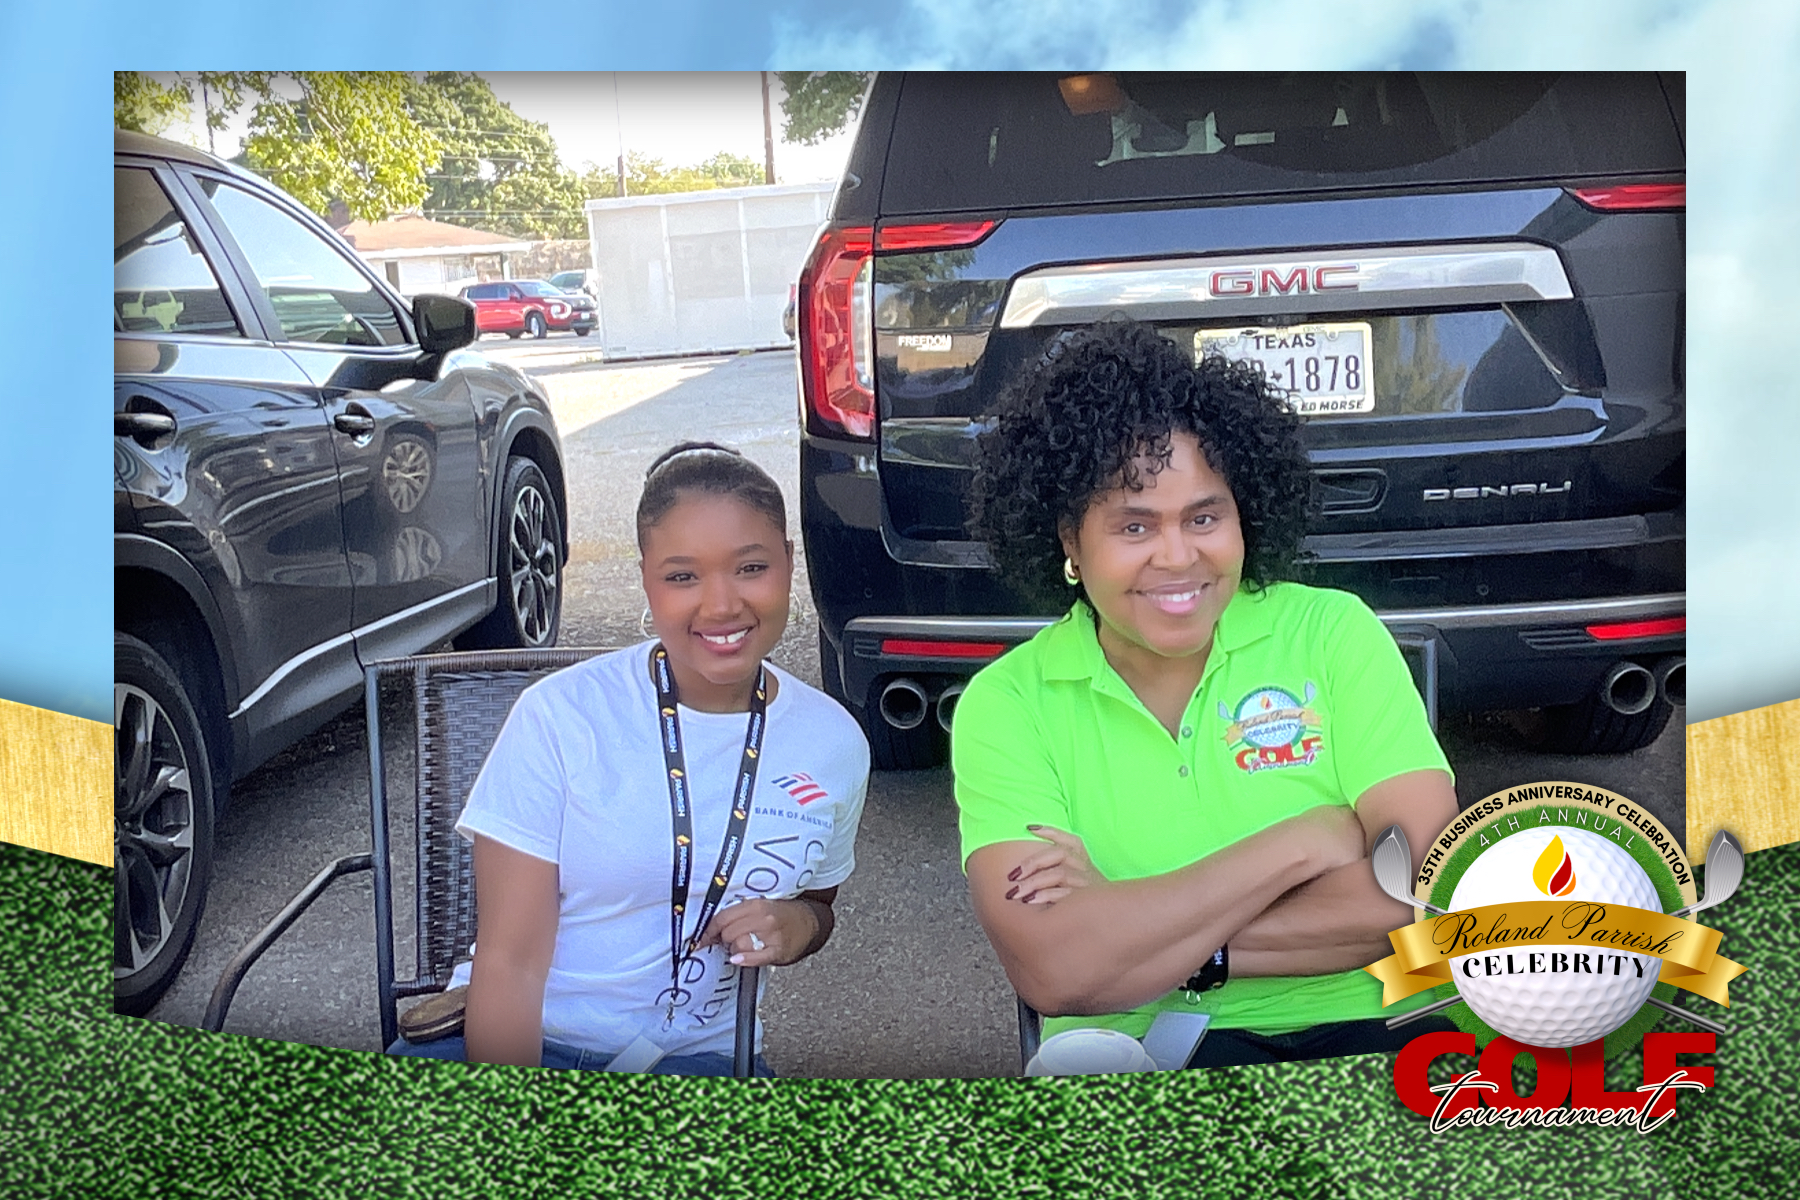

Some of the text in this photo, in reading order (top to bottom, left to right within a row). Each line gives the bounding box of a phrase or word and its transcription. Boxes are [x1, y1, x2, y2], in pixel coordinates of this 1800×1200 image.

[1210, 265, 1359, 297] GMC
[898, 334, 952, 347] FREEDOM
[1254, 333, 1316, 350] TEXAS
[1319, 399, 1364, 412] MORSE
[1423, 480, 1572, 501] DENALI
[1235, 736, 1322, 771] GOLF
[675, 779, 686, 817] PARRISH
[755, 806, 784, 817] BANK
[787, 811, 798, 820] OF
[720, 835, 738, 876] PARRISH
